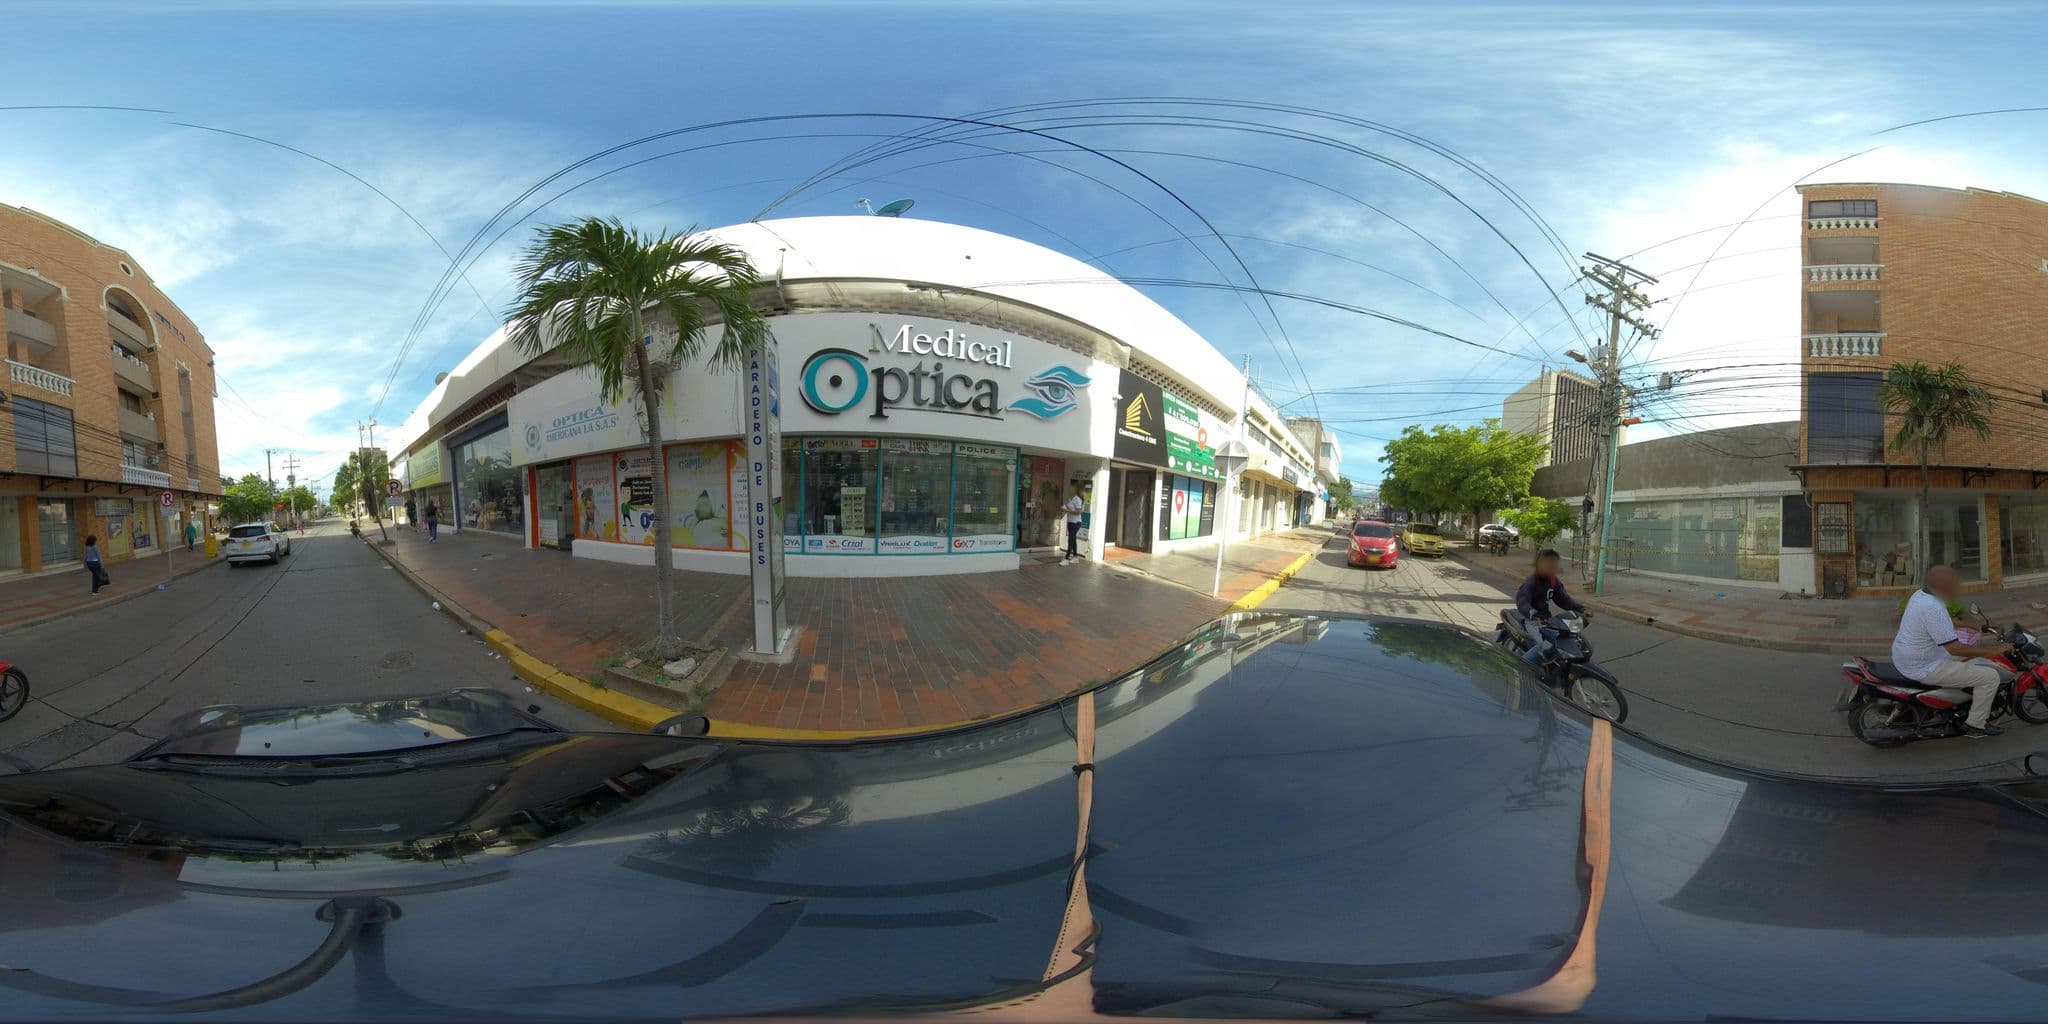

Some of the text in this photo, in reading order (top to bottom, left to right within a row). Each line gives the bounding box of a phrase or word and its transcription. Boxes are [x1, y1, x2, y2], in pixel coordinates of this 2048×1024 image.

[868, 322, 1013, 369] Medical
[799, 348, 1004, 420] Optica
[552, 405, 605, 428] OPTICA
[750, 349, 765, 565] PARADERO DE BUSES
[959, 445, 997, 455] POLICE
